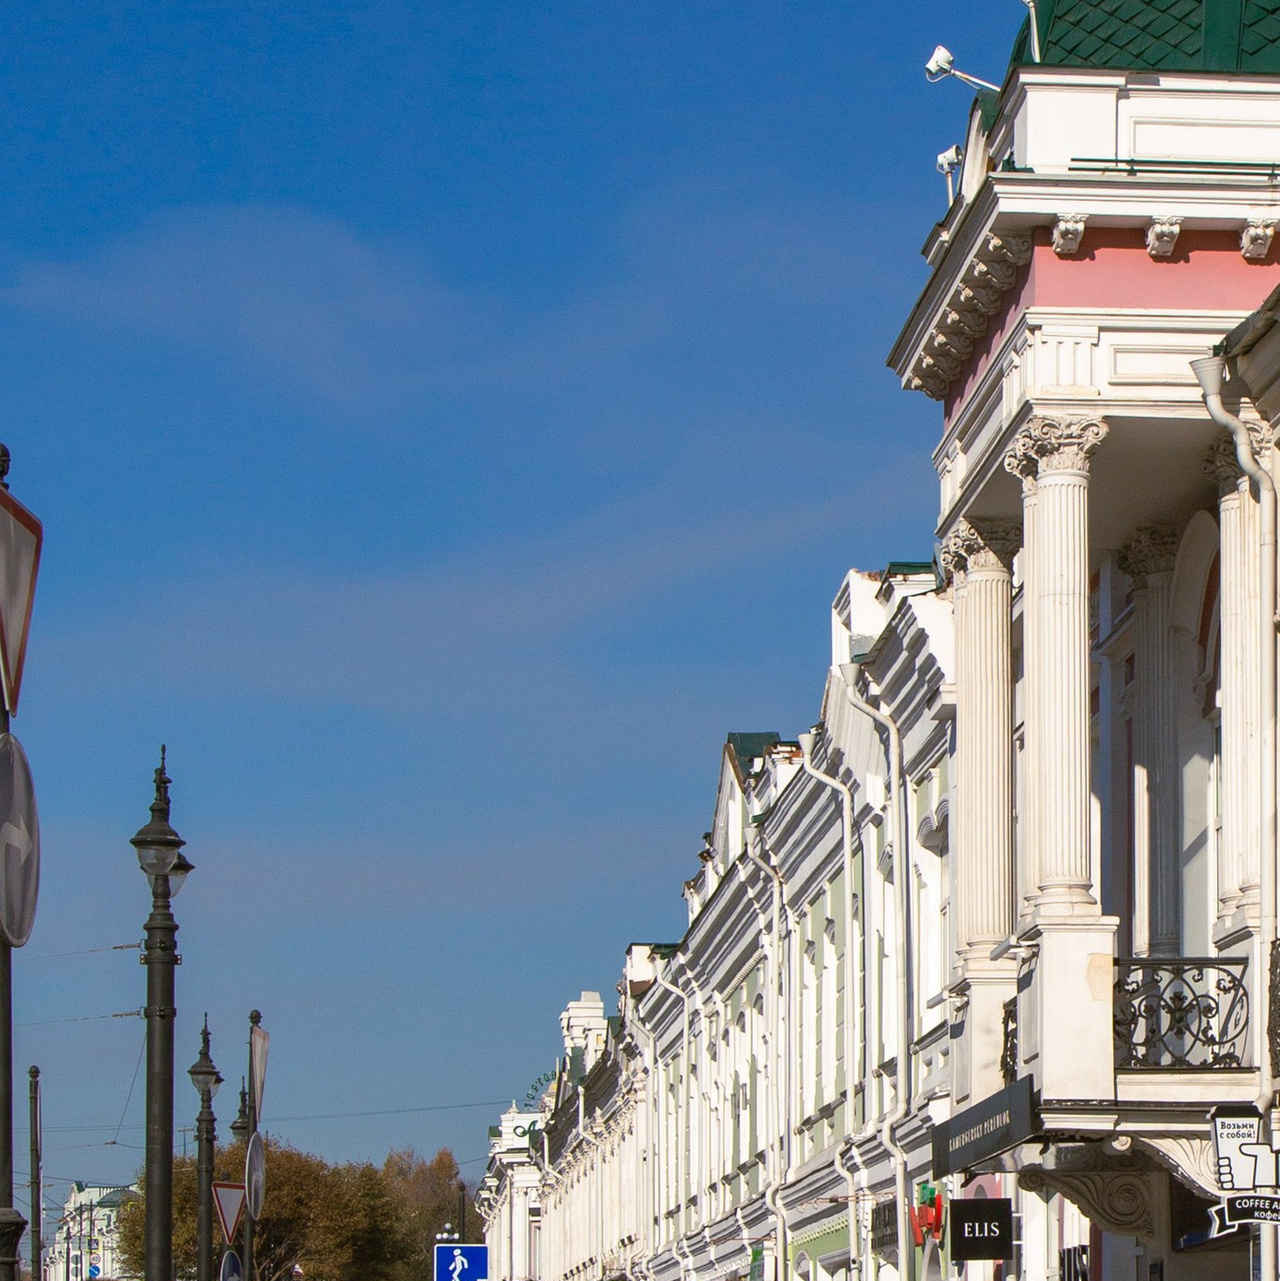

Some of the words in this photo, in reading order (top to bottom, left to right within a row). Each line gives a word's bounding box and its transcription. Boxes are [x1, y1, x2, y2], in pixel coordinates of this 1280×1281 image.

[1220, 1121, 1255, 1130] Возьми
[1226, 1130, 1256, 1139] собой!
[1235, 1199, 1271, 1209] COFFEE
[964, 1222, 1000, 1237] ELIS
